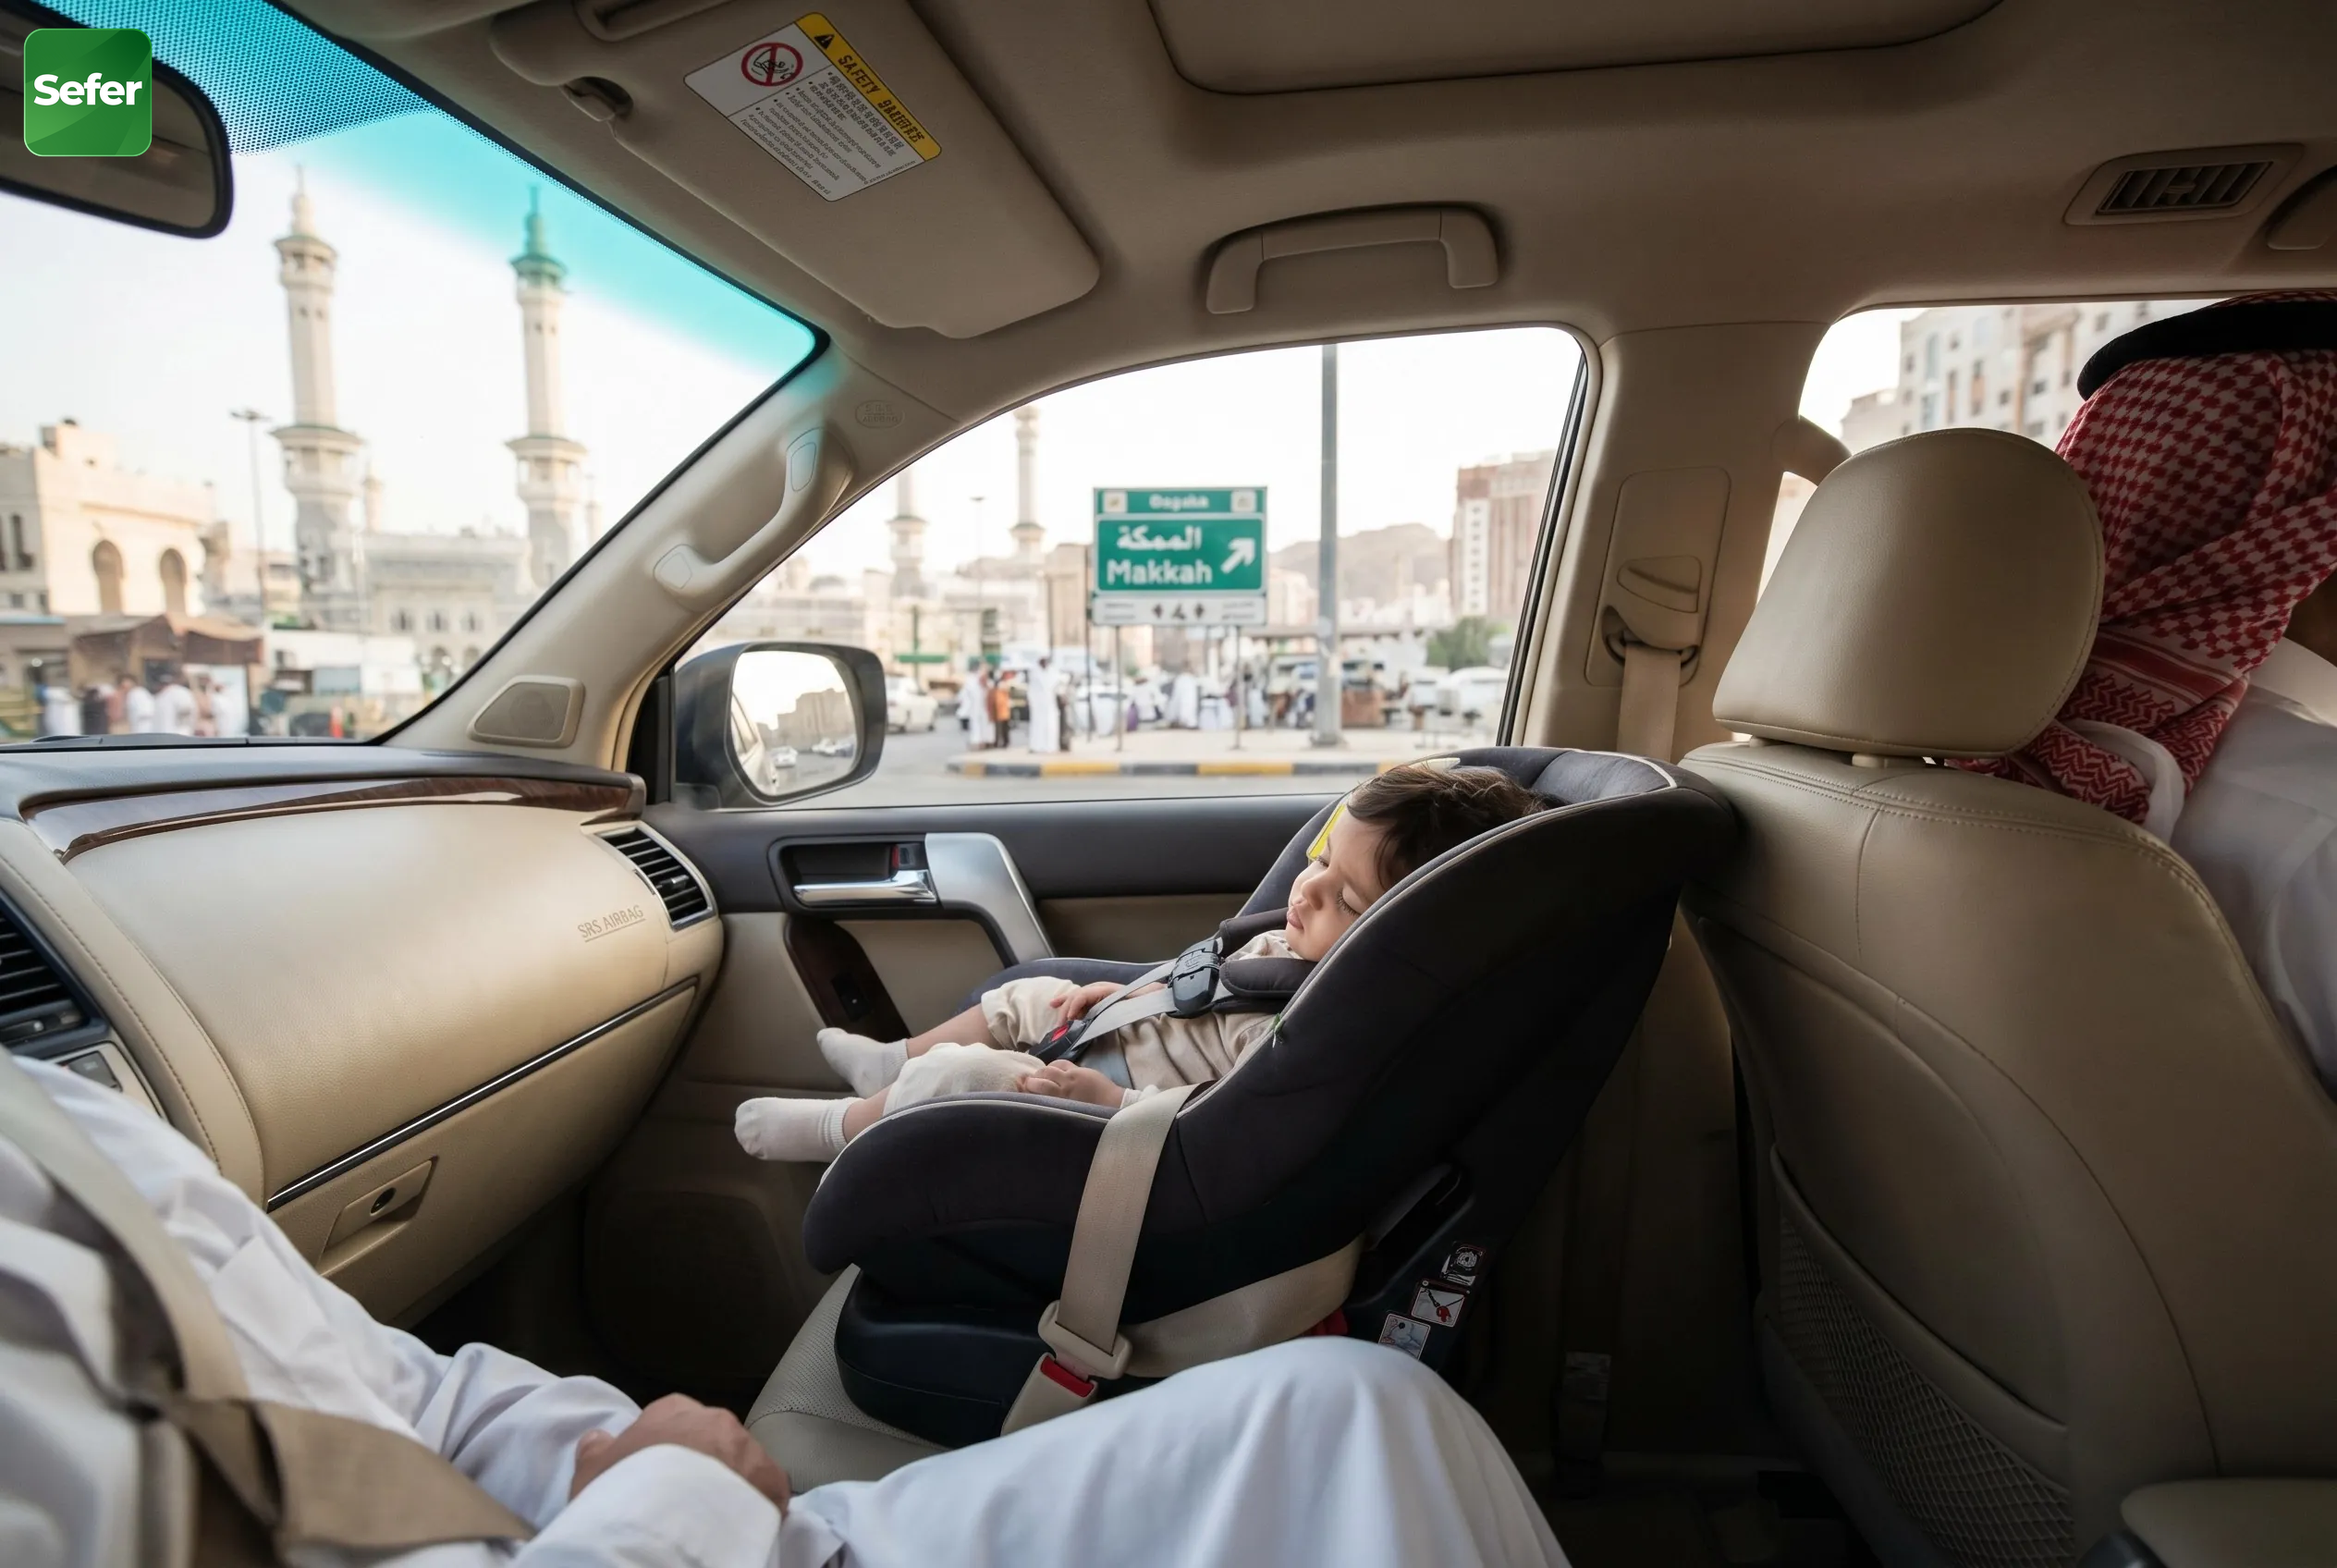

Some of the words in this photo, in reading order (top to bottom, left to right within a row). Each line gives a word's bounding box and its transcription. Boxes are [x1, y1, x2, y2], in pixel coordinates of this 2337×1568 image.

[838, 55, 881, 94] SAFETY
[1107, 559, 1213, 585] Makkah
[577, 919, 603, 938] SRS
[603, 904, 643, 930] AIRBAG
